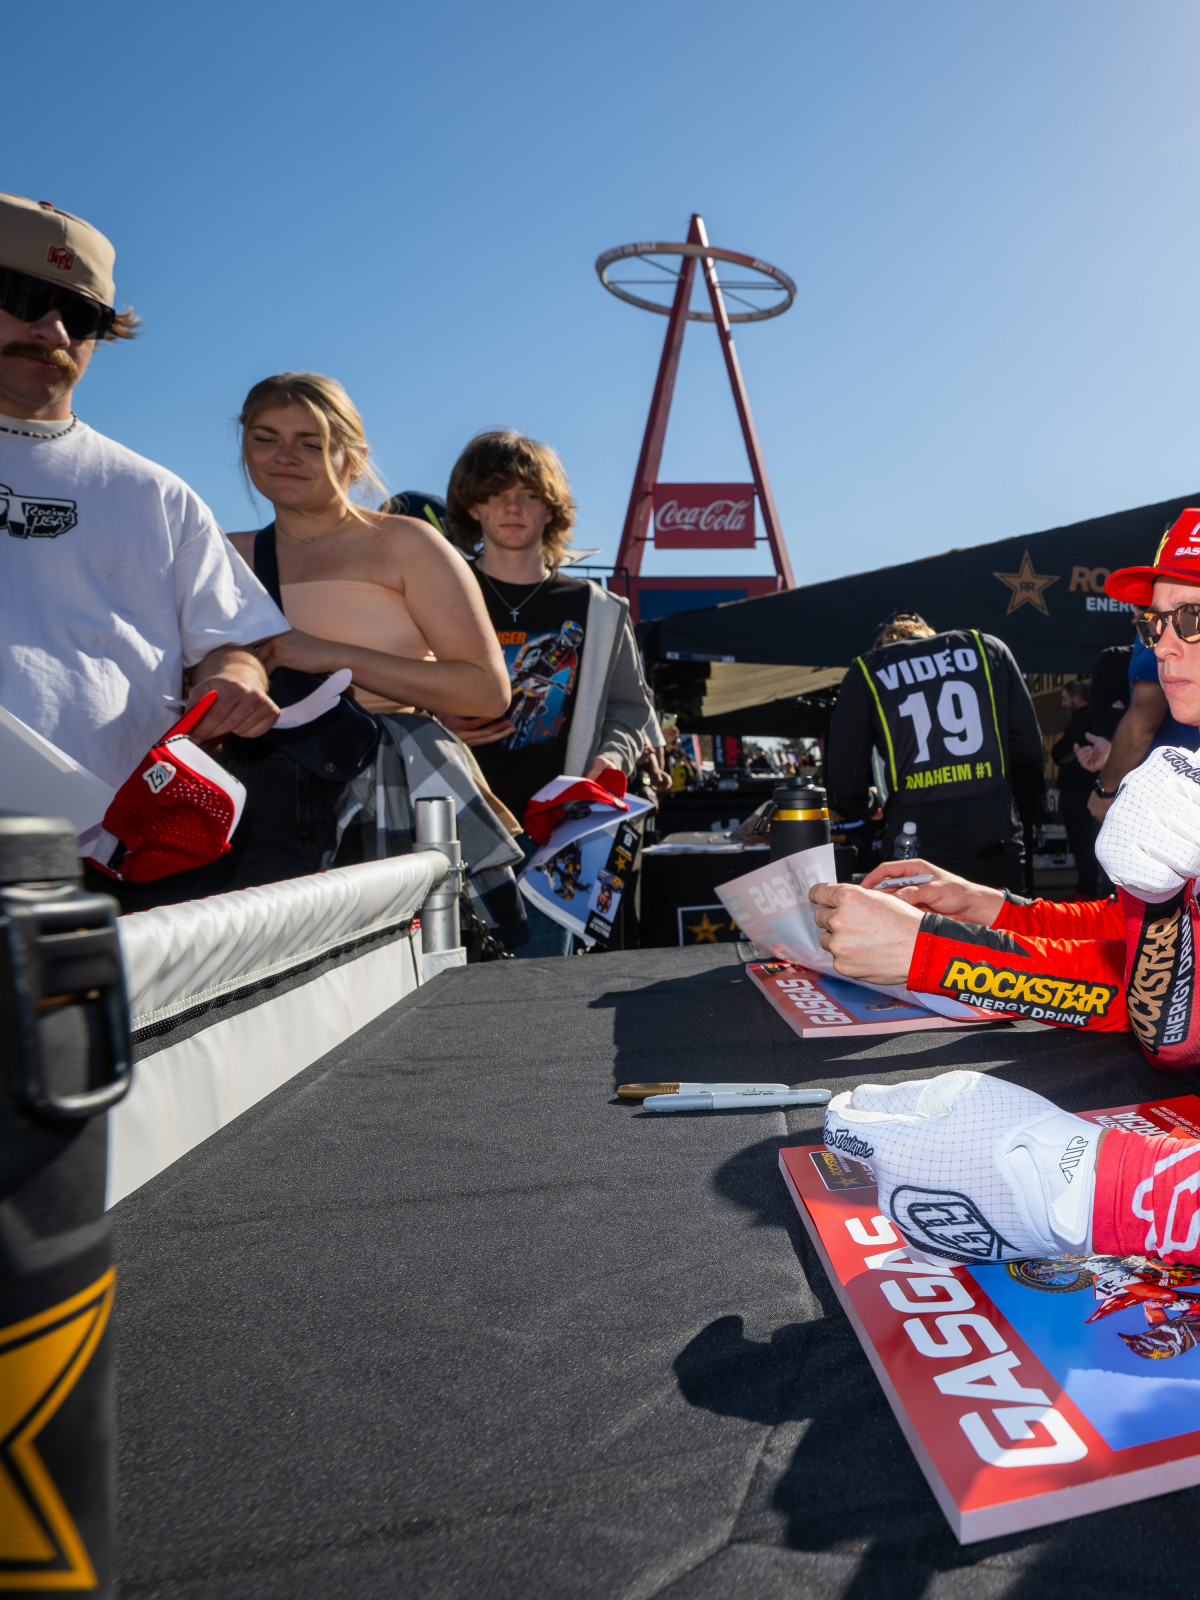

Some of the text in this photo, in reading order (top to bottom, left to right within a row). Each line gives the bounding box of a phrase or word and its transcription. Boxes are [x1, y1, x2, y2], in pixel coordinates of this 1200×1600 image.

[876, 648, 978, 691] VIDEO
[898, 680, 984, 764] 19
[905, 761, 993, 790] ANAHEIM #1
[1162, 748, 1191, 776] Troy
[775, 978, 853, 1026] GASGAS
[944, 960, 1111, 1015] ROCKSTAR
[1127, 906, 1182, 1052] ROCKSTAR
[958, 993, 1031, 1015] ENERGY
[1030, 1007, 1087, 1026] DRINK
[1162, 975, 1191, 1045] ENERGY
[835, 1128, 875, 1159] Designs
[844, 1214, 1089, 1468] GASGAS
